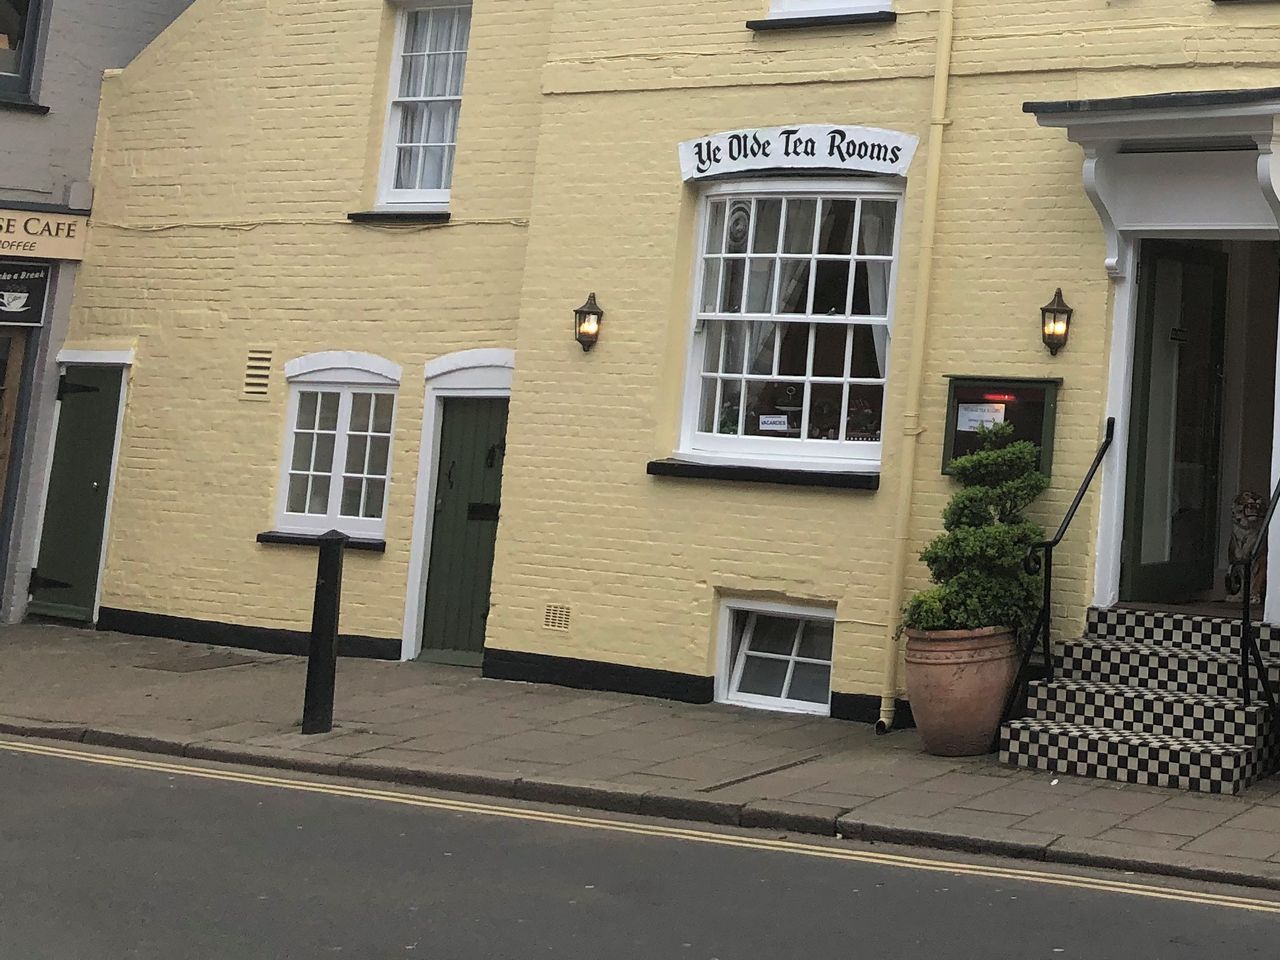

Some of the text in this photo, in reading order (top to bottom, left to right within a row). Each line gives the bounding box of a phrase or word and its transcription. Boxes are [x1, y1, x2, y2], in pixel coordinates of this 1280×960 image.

[693, 128, 902, 173] Ye Olde Tea Rooms
[23, 217, 77, 238] CAFÉ
[0, 240, 37, 251] OFFEE
